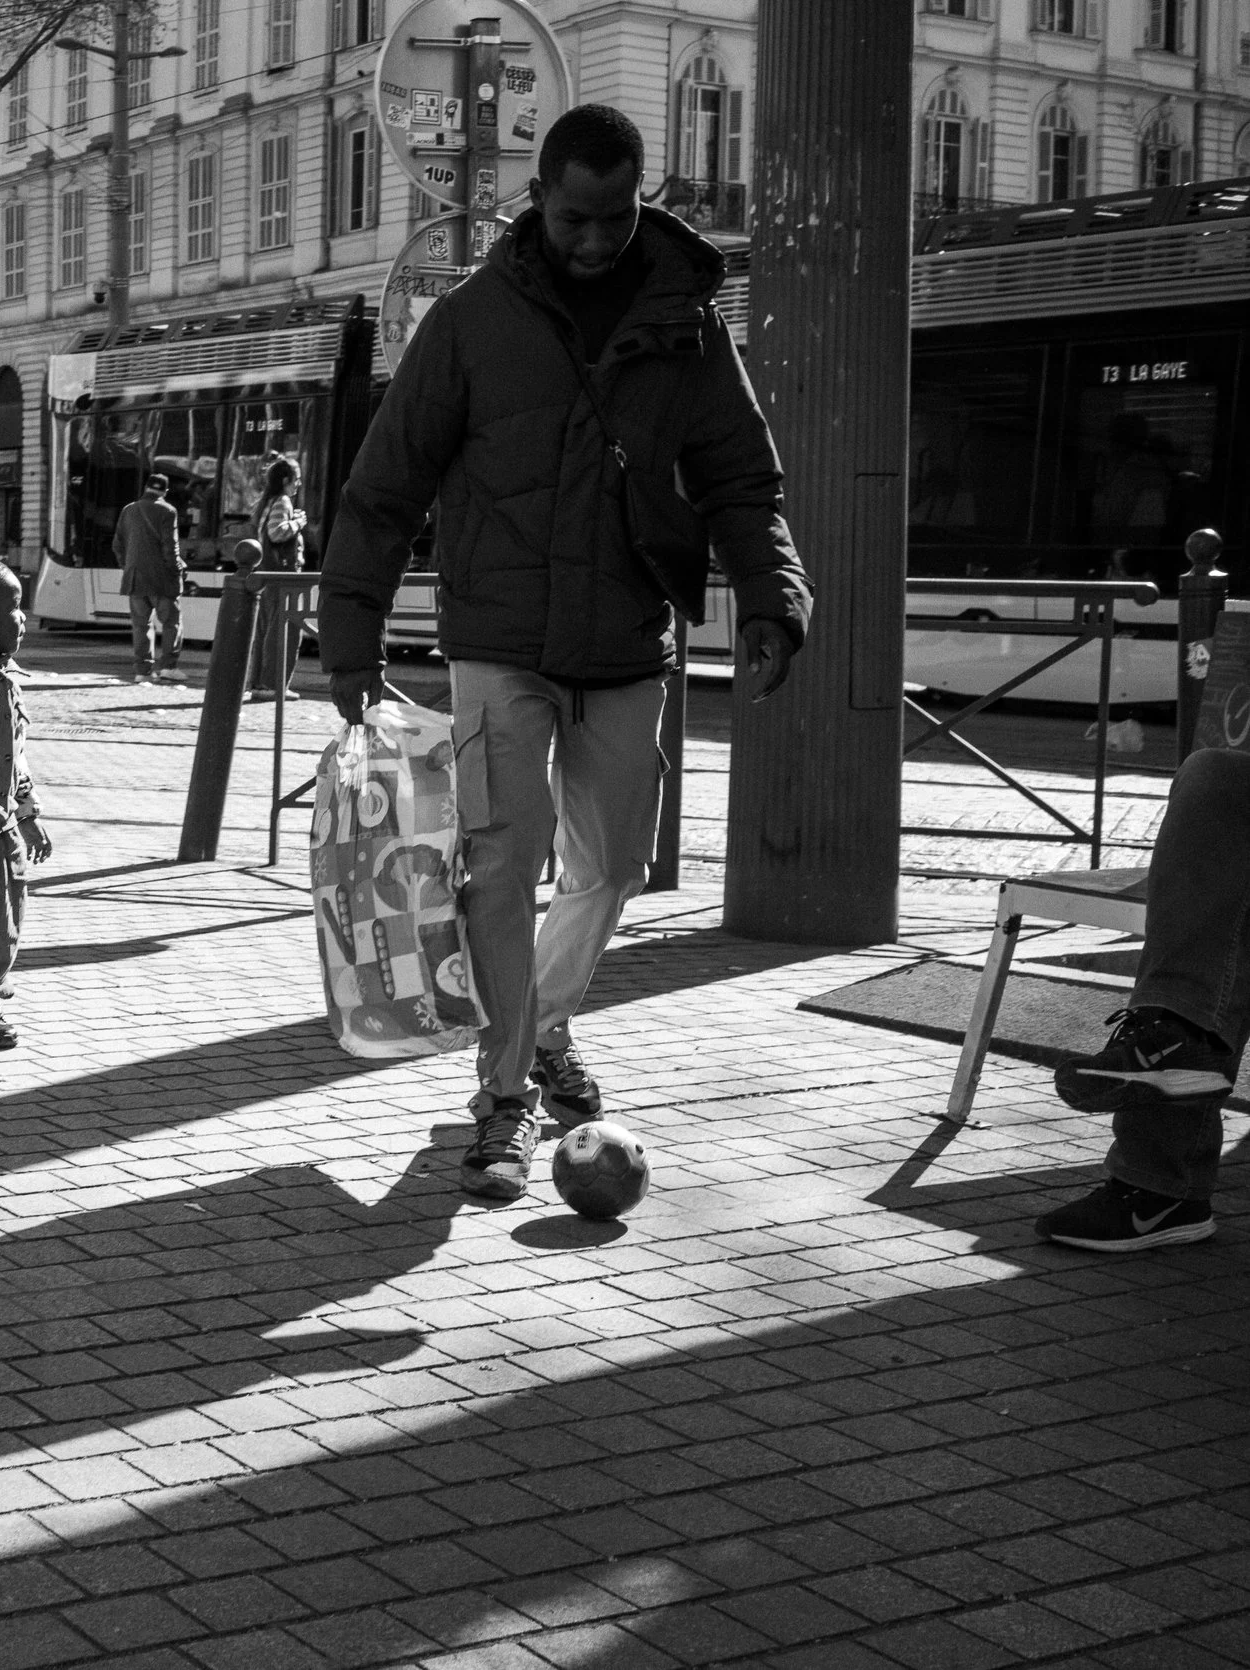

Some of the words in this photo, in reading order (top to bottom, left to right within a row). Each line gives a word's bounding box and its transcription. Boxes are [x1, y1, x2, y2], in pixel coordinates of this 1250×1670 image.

[425, 166, 455, 184] 1UP
[1102, 365, 1120, 383] T3
[1130, 364, 1149, 381] LA
[1152, 361, 1189, 380] GAYE
